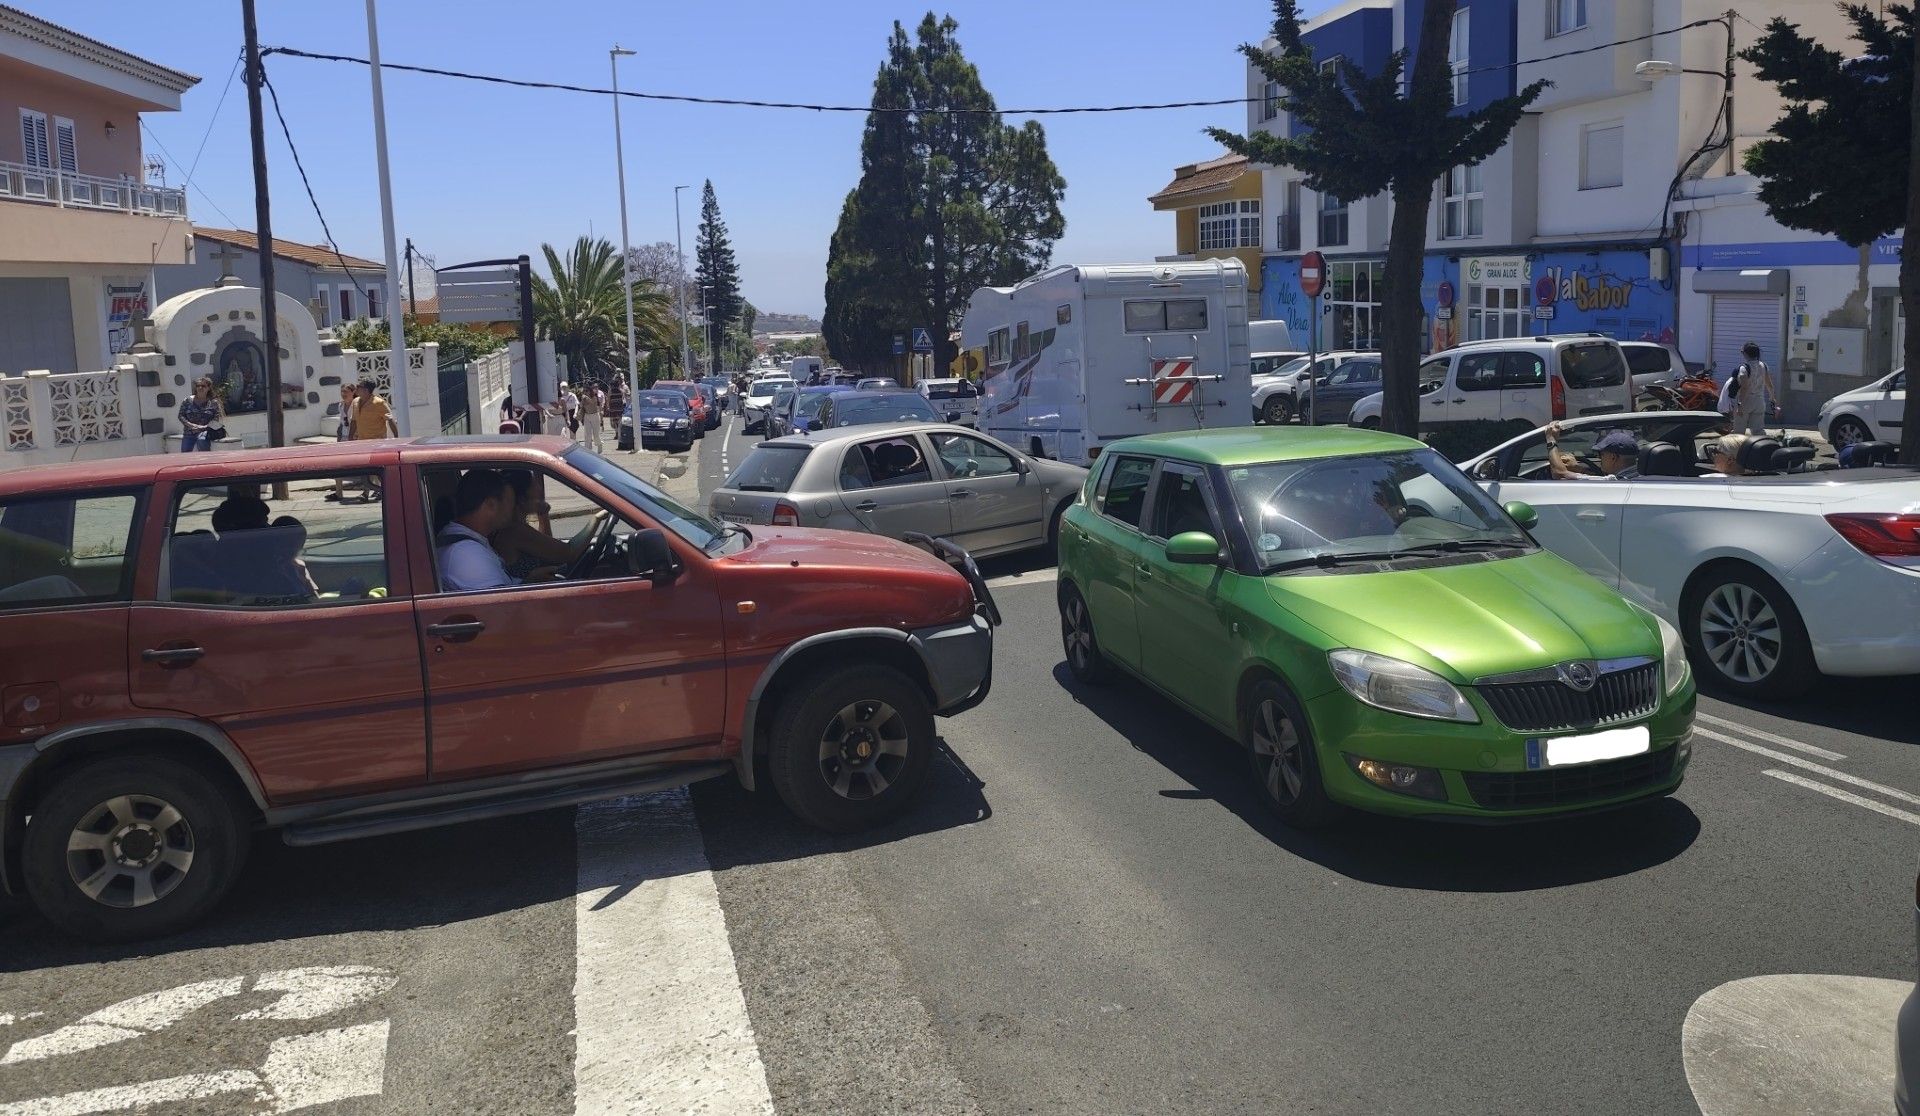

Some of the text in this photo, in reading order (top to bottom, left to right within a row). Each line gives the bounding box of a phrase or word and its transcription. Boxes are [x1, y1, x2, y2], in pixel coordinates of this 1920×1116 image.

[1487, 269, 1517, 278] GRAN ALOE
[1278, 280, 1297, 305] Aloe
[1287, 306, 1309, 331] Vera
